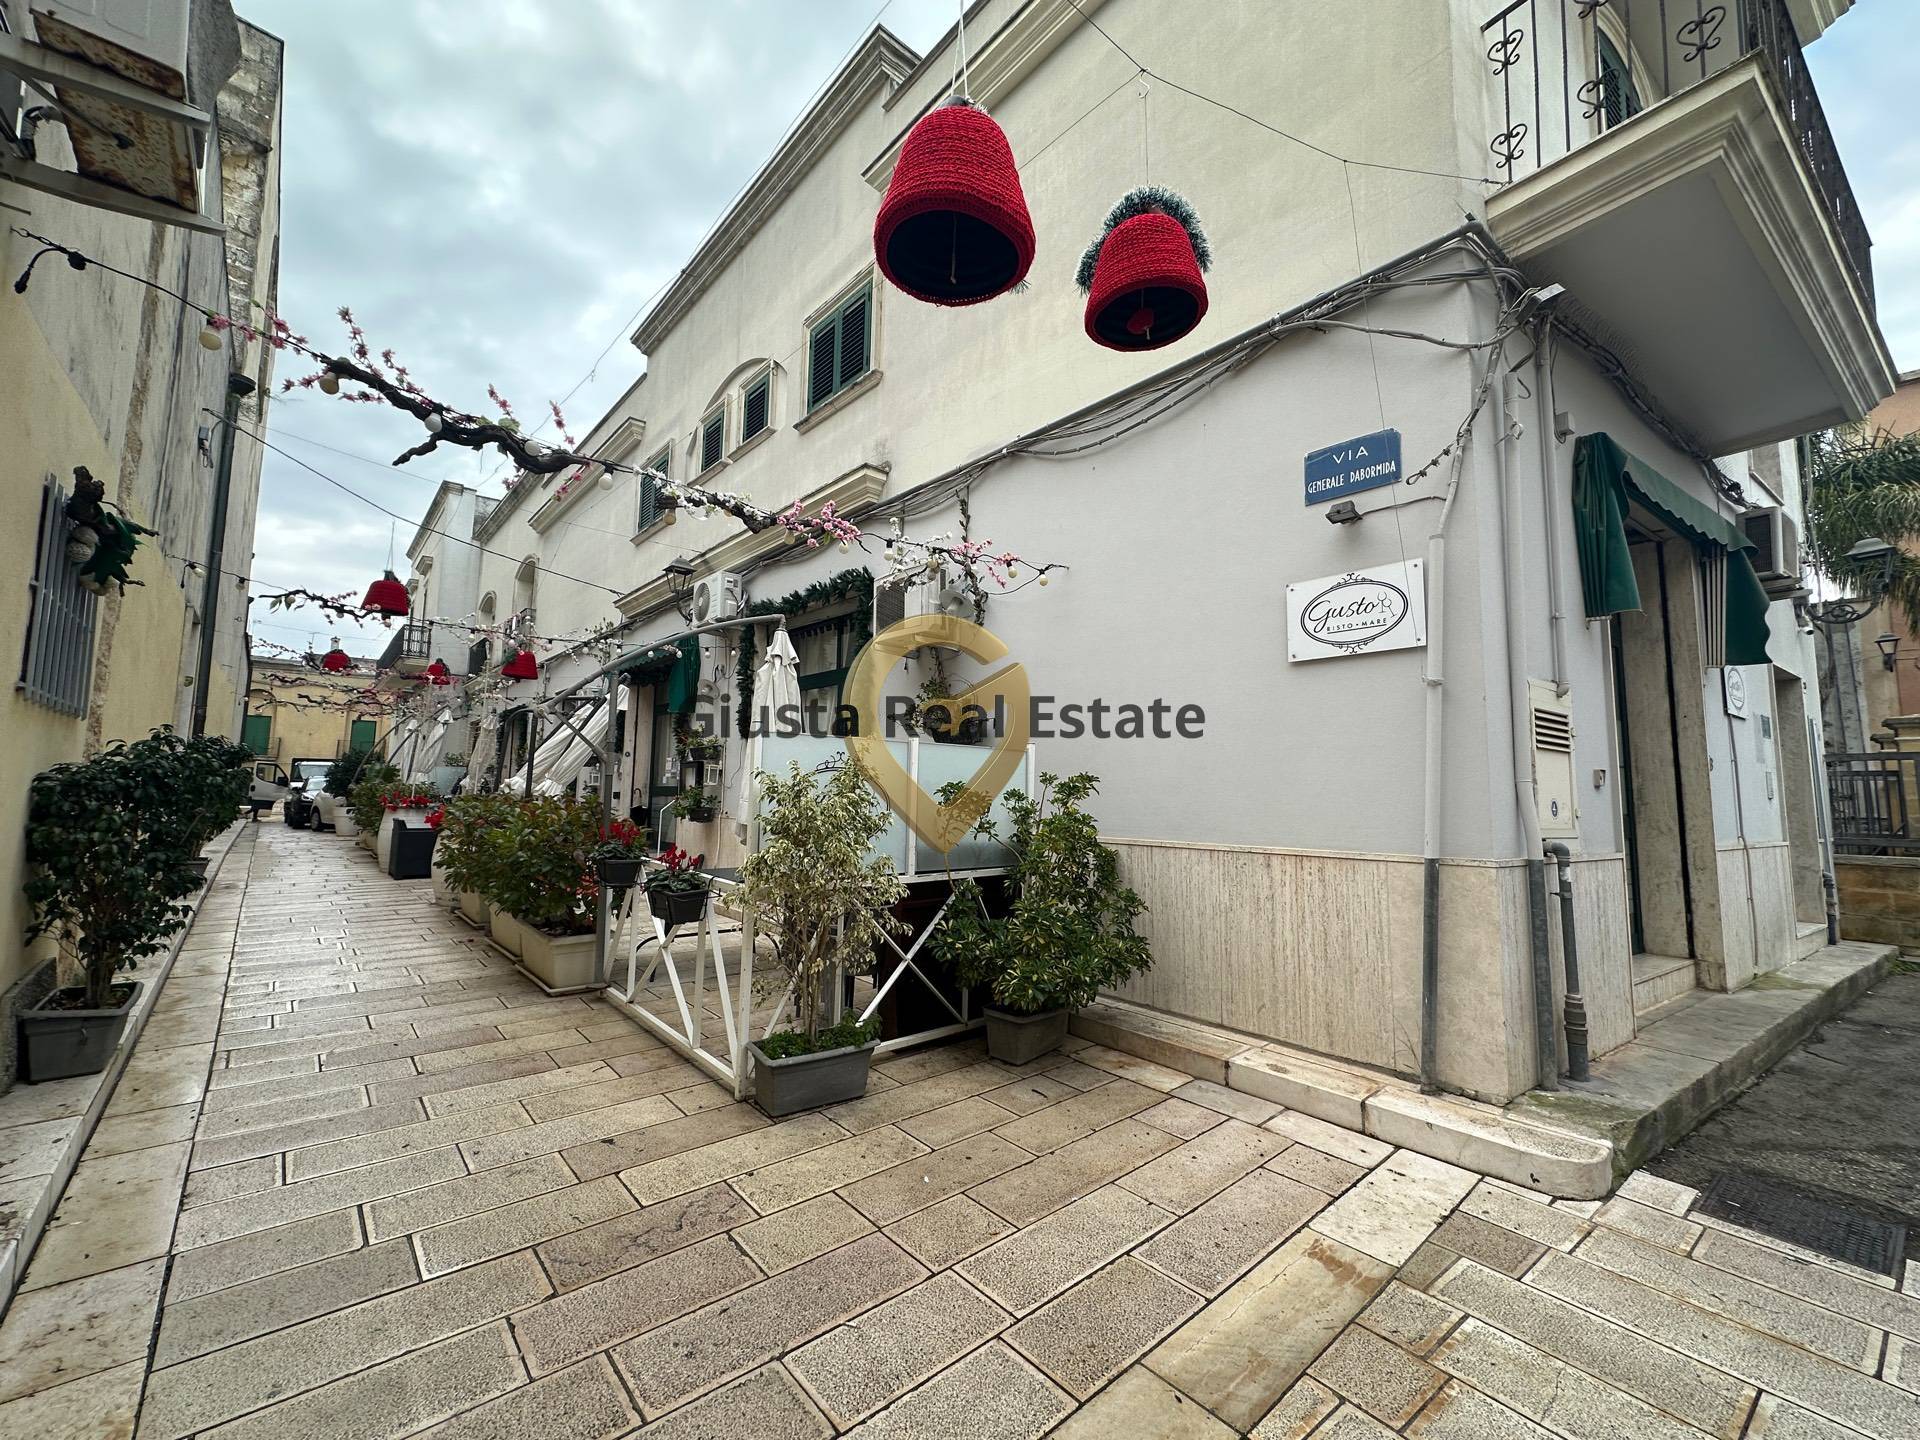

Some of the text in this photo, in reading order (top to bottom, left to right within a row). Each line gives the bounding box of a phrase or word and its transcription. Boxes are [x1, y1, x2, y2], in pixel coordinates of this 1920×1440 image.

[1333, 446, 1368, 464] VIA
[1308, 460, 1396, 493] GENERALE DABORMIDA
[1308, 597, 1379, 633] Gusto
